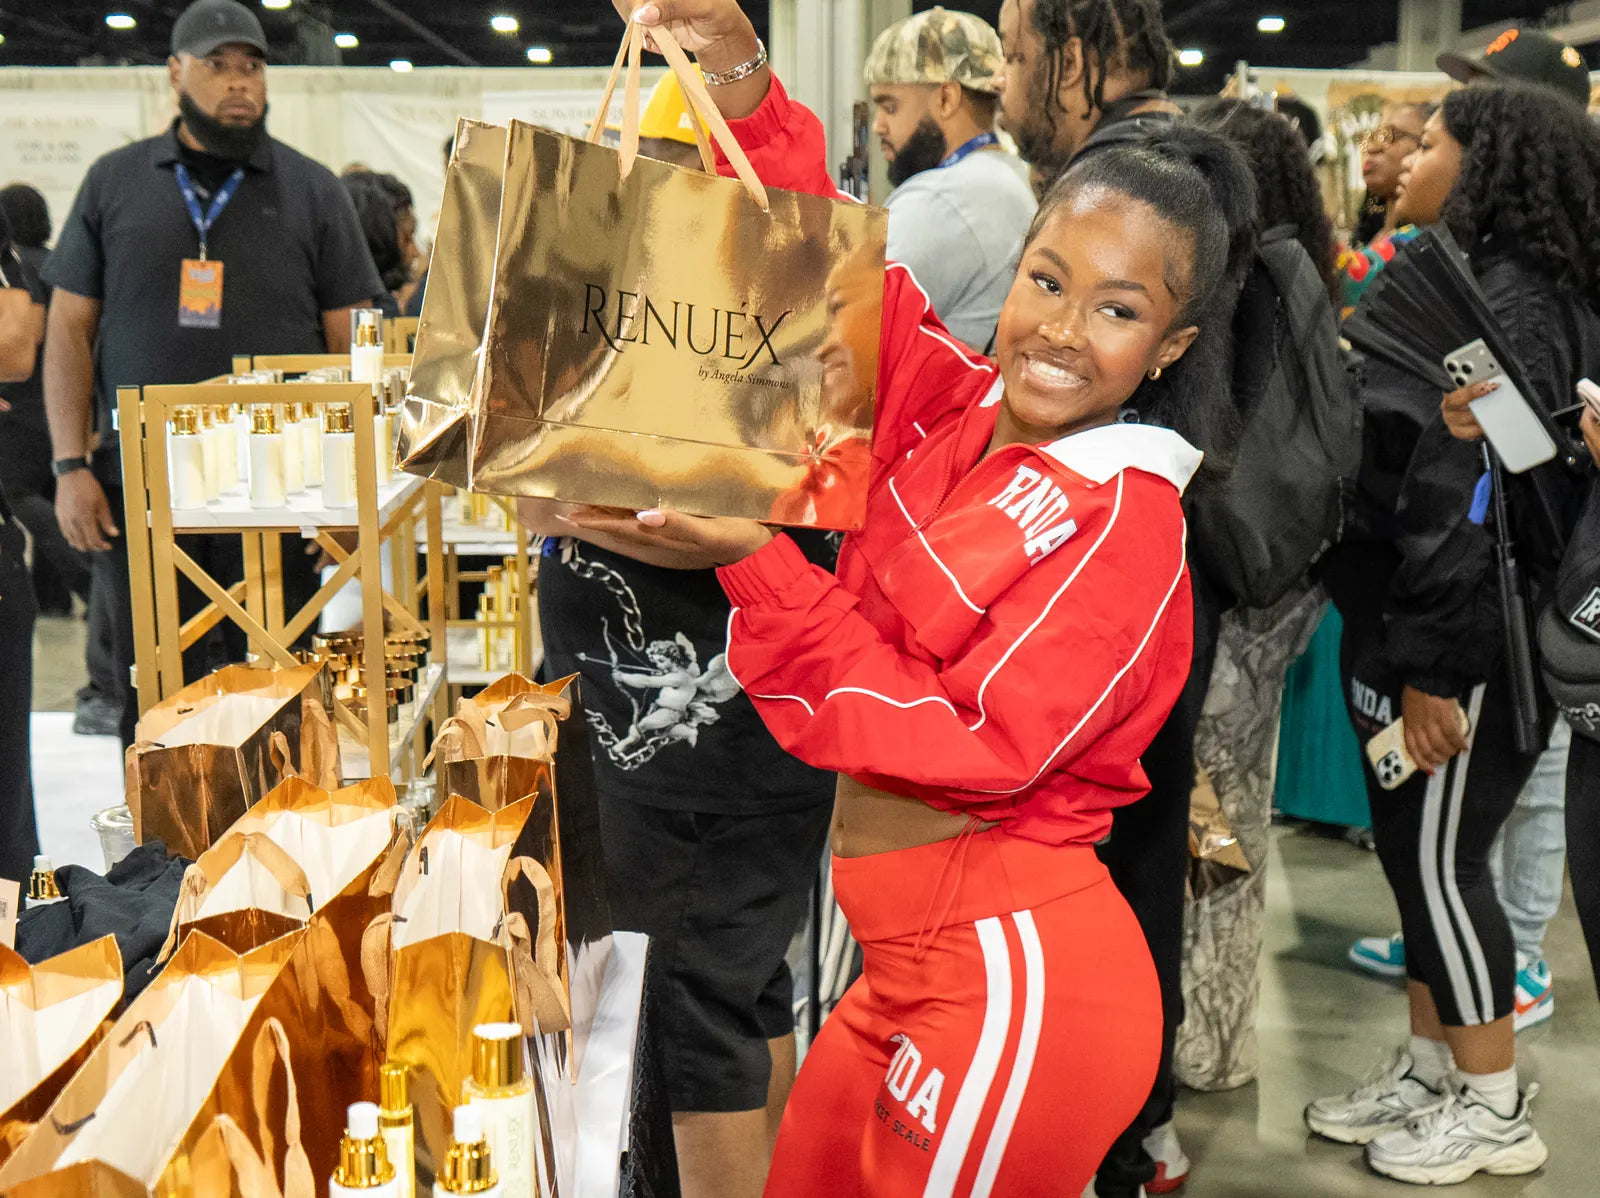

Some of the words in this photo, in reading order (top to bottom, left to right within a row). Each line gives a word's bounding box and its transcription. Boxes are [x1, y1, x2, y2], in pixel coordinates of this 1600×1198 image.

[698, 365, 710, 380] by
[710, 369, 744, 384] Angela
[745, 373, 790, 389] Simmons
[893, 1119, 931, 1151] SCALE
